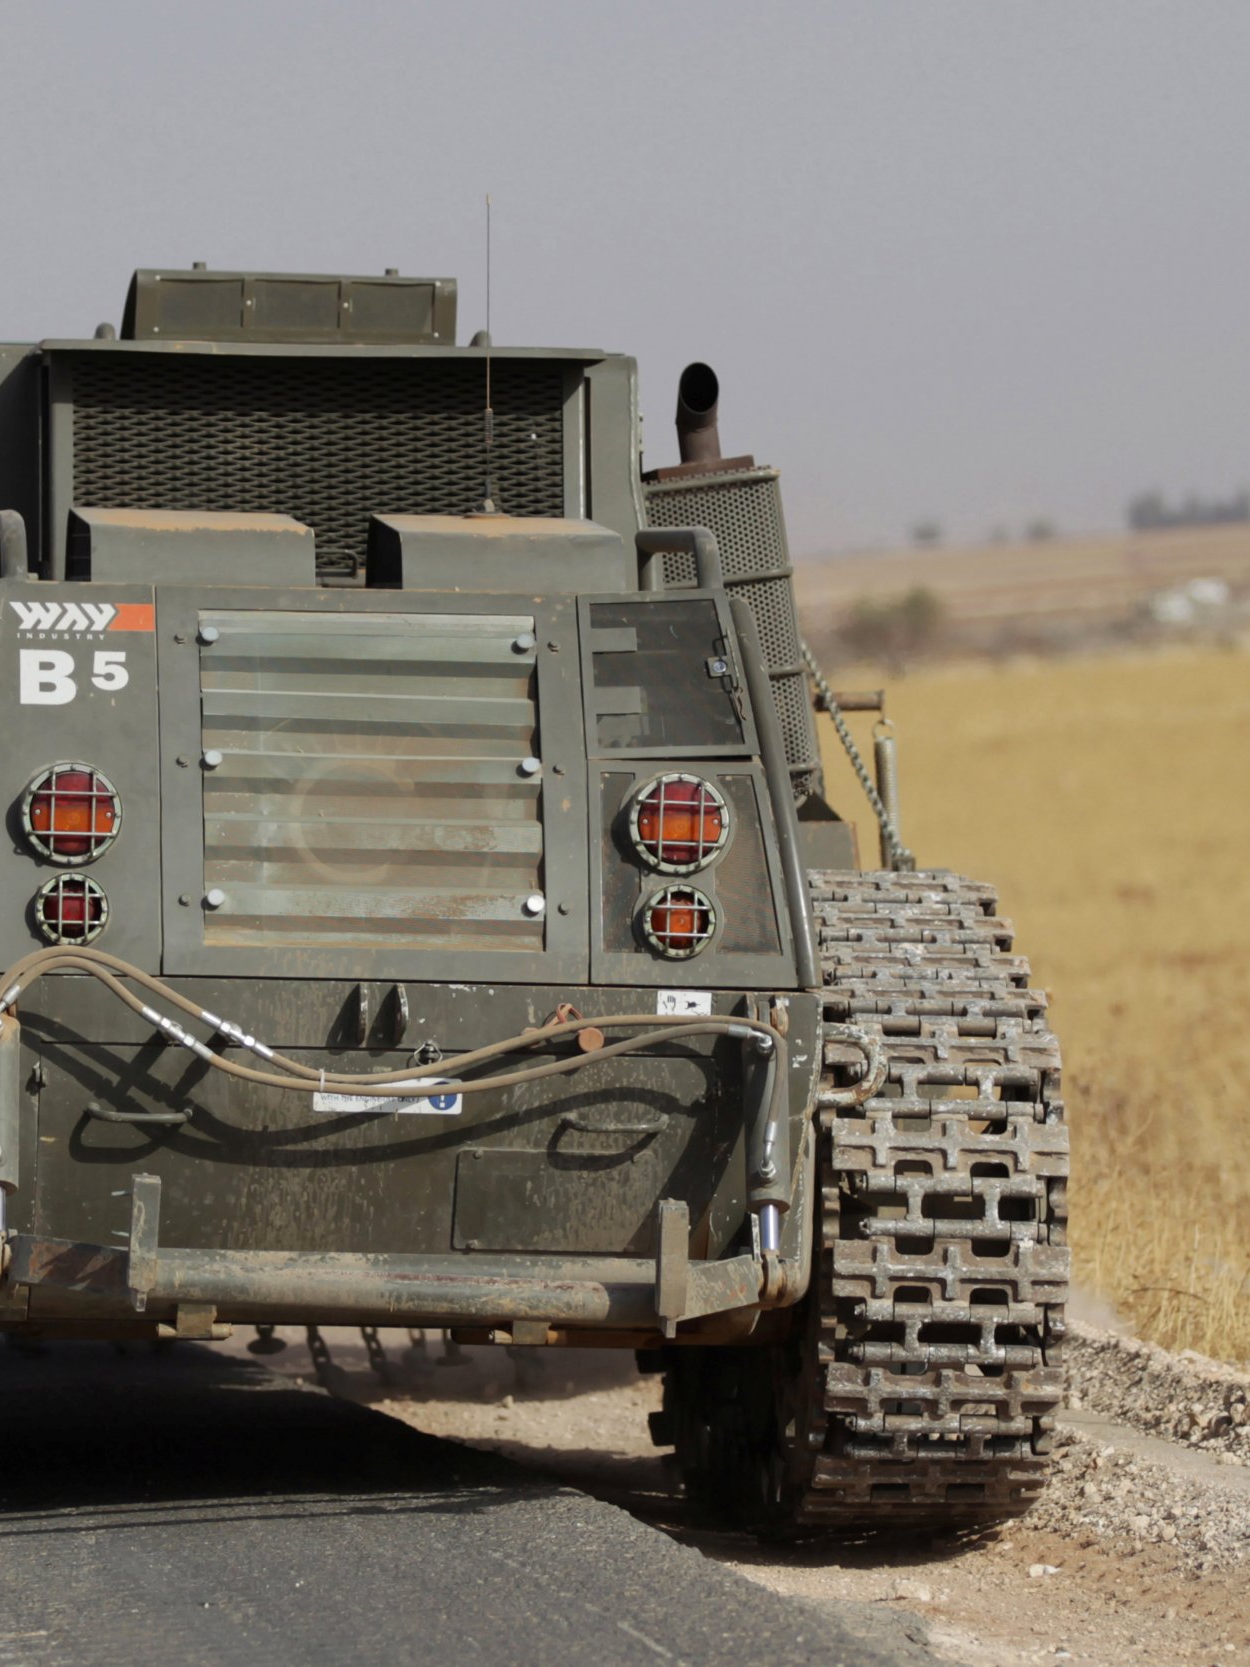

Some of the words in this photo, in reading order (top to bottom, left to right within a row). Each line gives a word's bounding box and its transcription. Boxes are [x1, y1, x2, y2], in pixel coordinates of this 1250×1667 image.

[9, 601, 116, 631] WAY
[16, 632, 106, 641] INDUSTRY
[19, 649, 77, 705] B
[91, 651, 129, 691] 5
[320, 1094, 339, 1102] WITH
